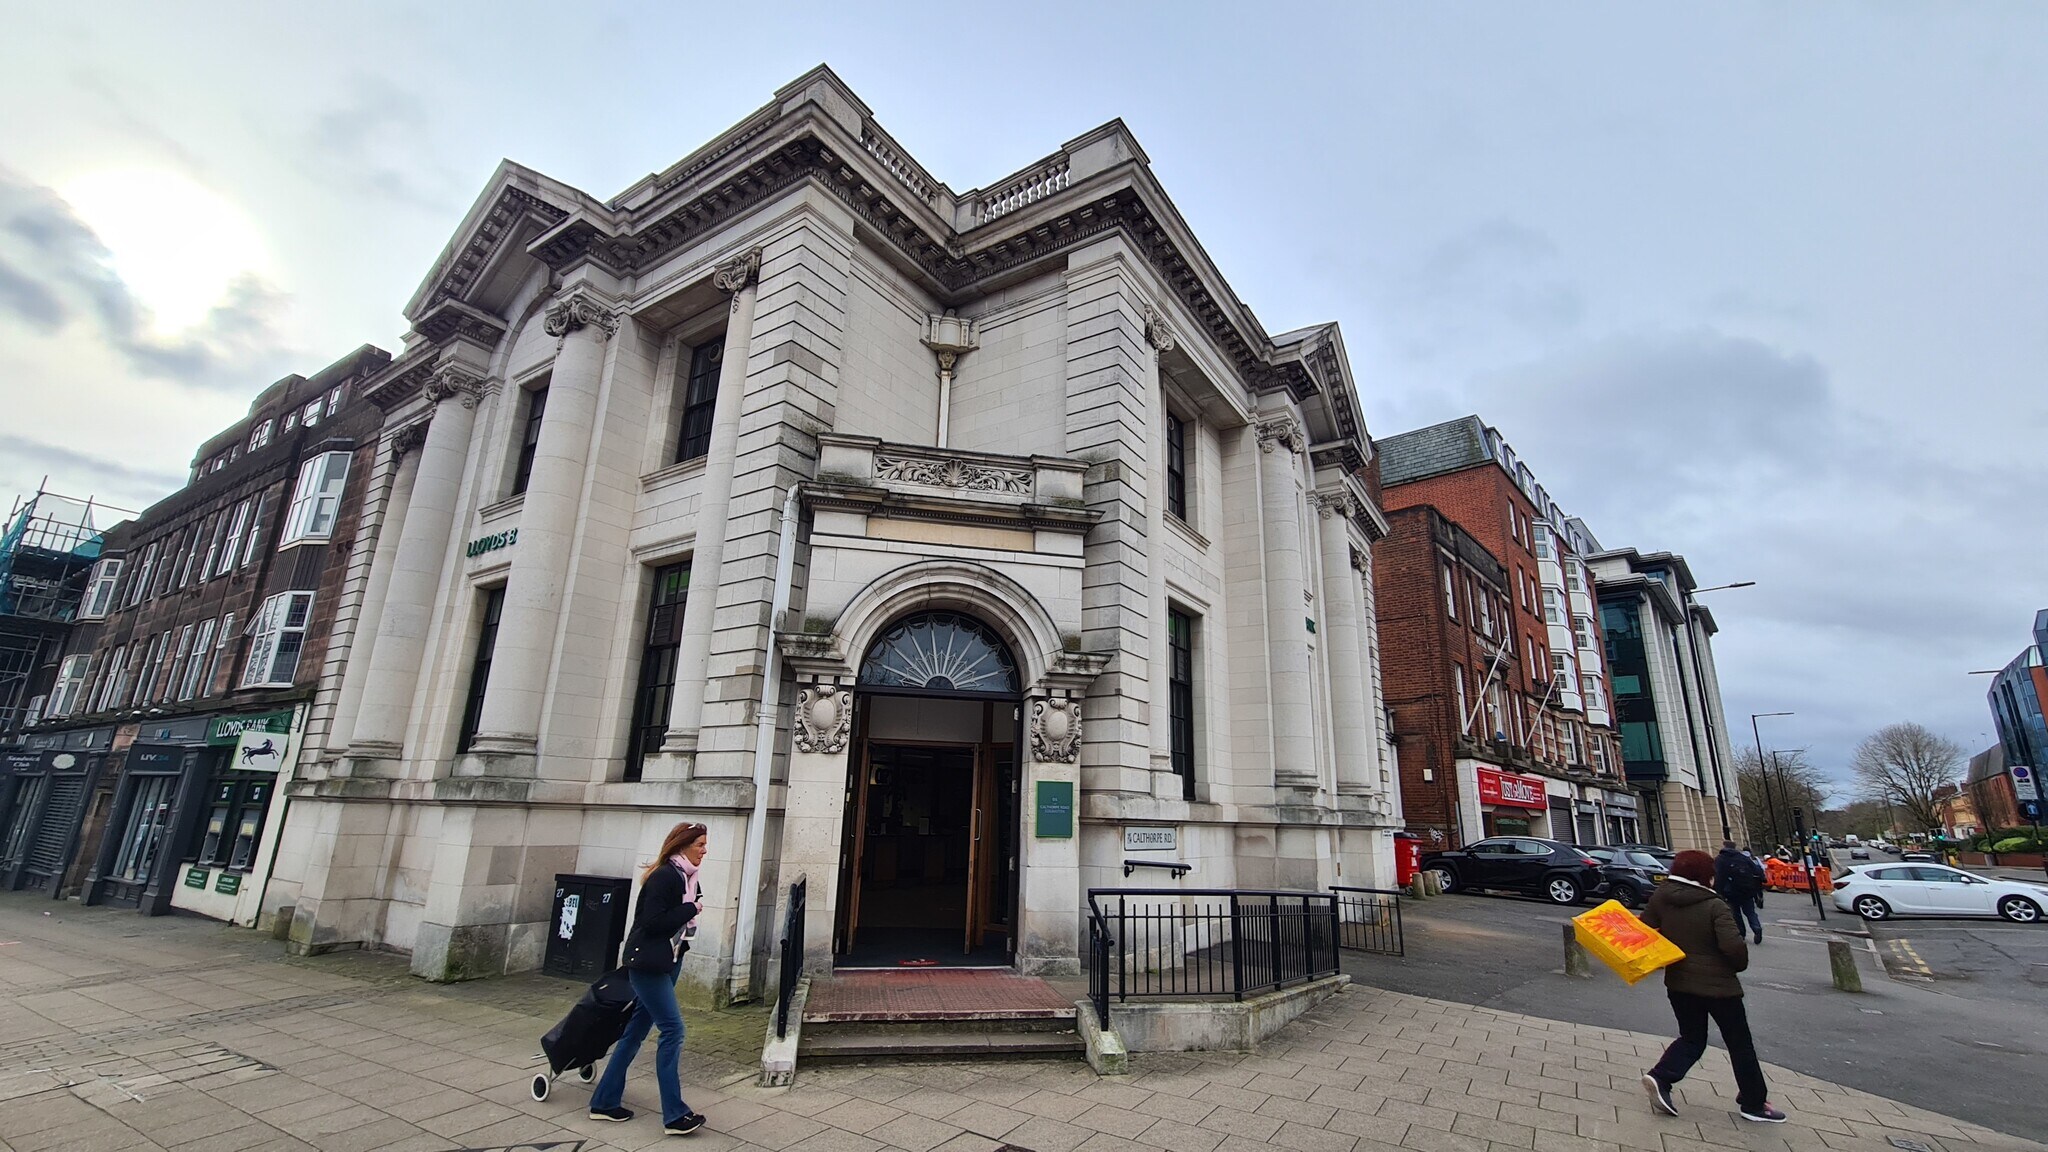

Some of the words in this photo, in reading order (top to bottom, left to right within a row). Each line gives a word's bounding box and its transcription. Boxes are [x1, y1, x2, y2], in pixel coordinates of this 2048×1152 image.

[466, 531, 508, 558] LLOYDS
[216, 720, 246, 738] LLOYDS
[1132, 832, 1163, 844] CALTHORPE
[556, 888, 564, 898] 27
[602, 893, 611, 903] 27
